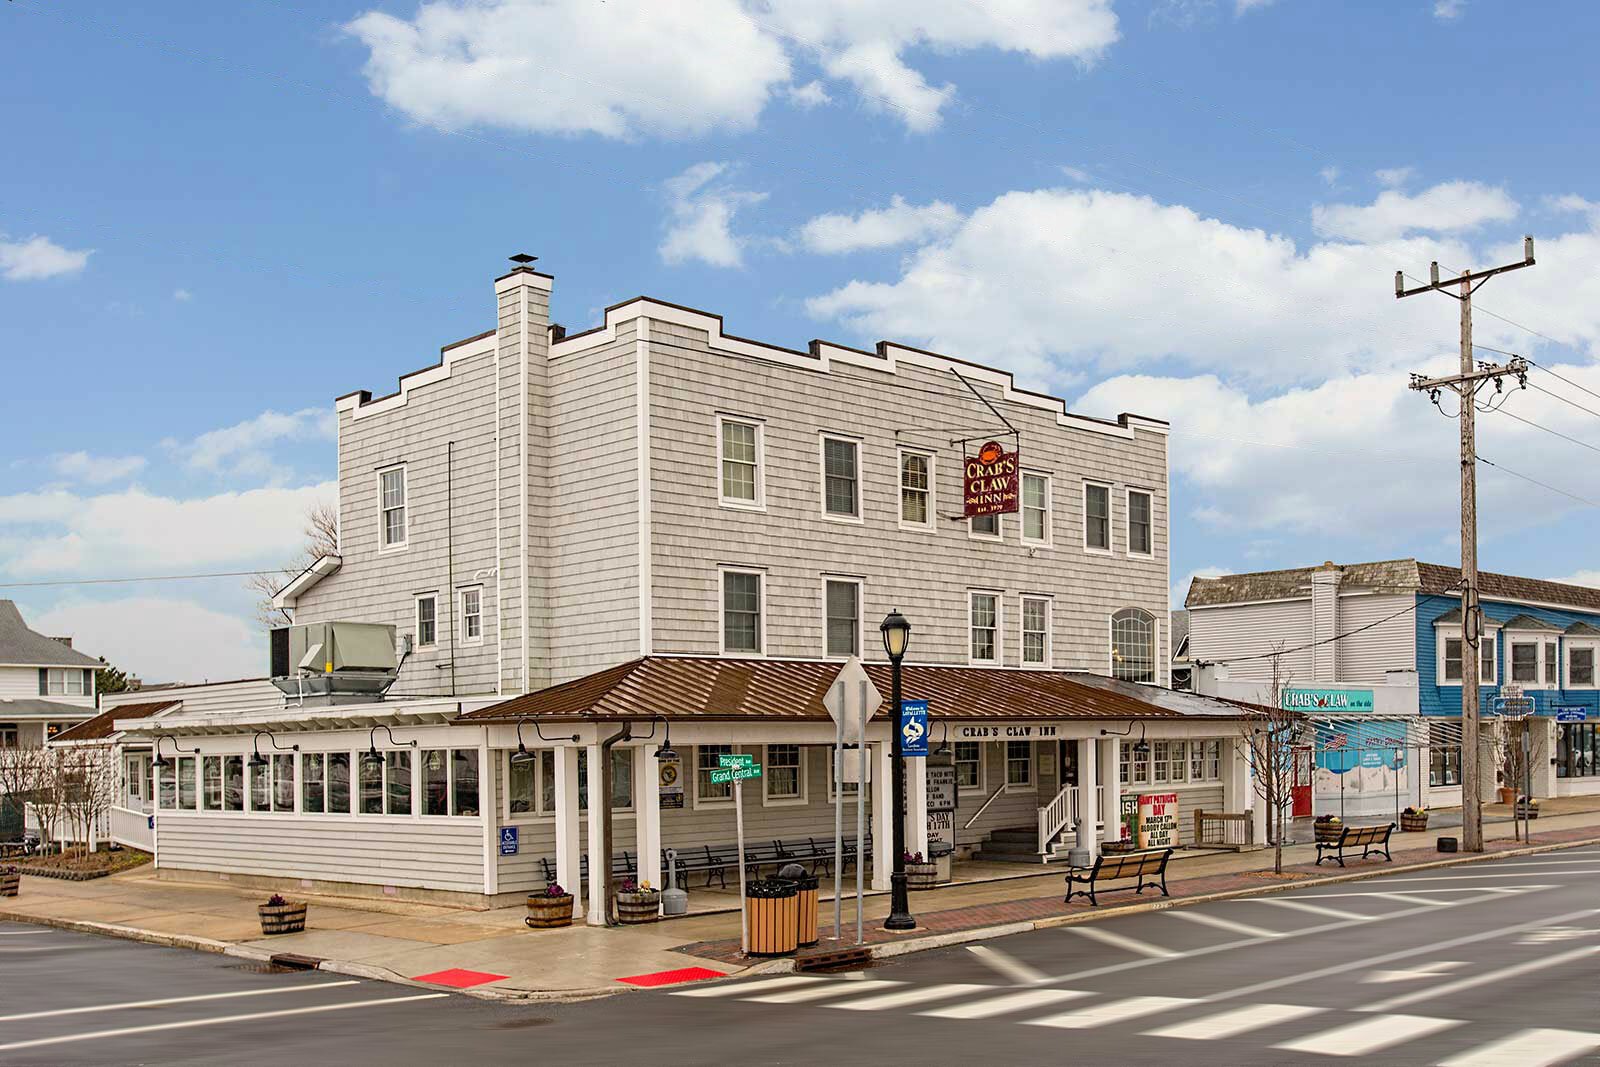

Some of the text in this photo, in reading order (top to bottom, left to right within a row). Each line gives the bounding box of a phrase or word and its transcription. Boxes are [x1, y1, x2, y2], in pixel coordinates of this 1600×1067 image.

[966, 458, 1014, 478] CRAB'S
[970, 476, 1011, 493] CLAW
[980, 492, 1002, 504] INN
[1285, 692, 1319, 707] CRAB'S
[1323, 693, 1348, 707] CLAW
[962, 726, 1056, 737] CRAB'S CLAW INN
[720, 757, 745, 767] President
[712, 770, 731, 783] Grand
[731, 767, 753, 780] Central
[1152, 804, 1165, 816] DAY
[936, 812, 950, 822] DAY
[1146, 816, 1164, 824] MARCH
[934, 820, 950, 830] 17TH
